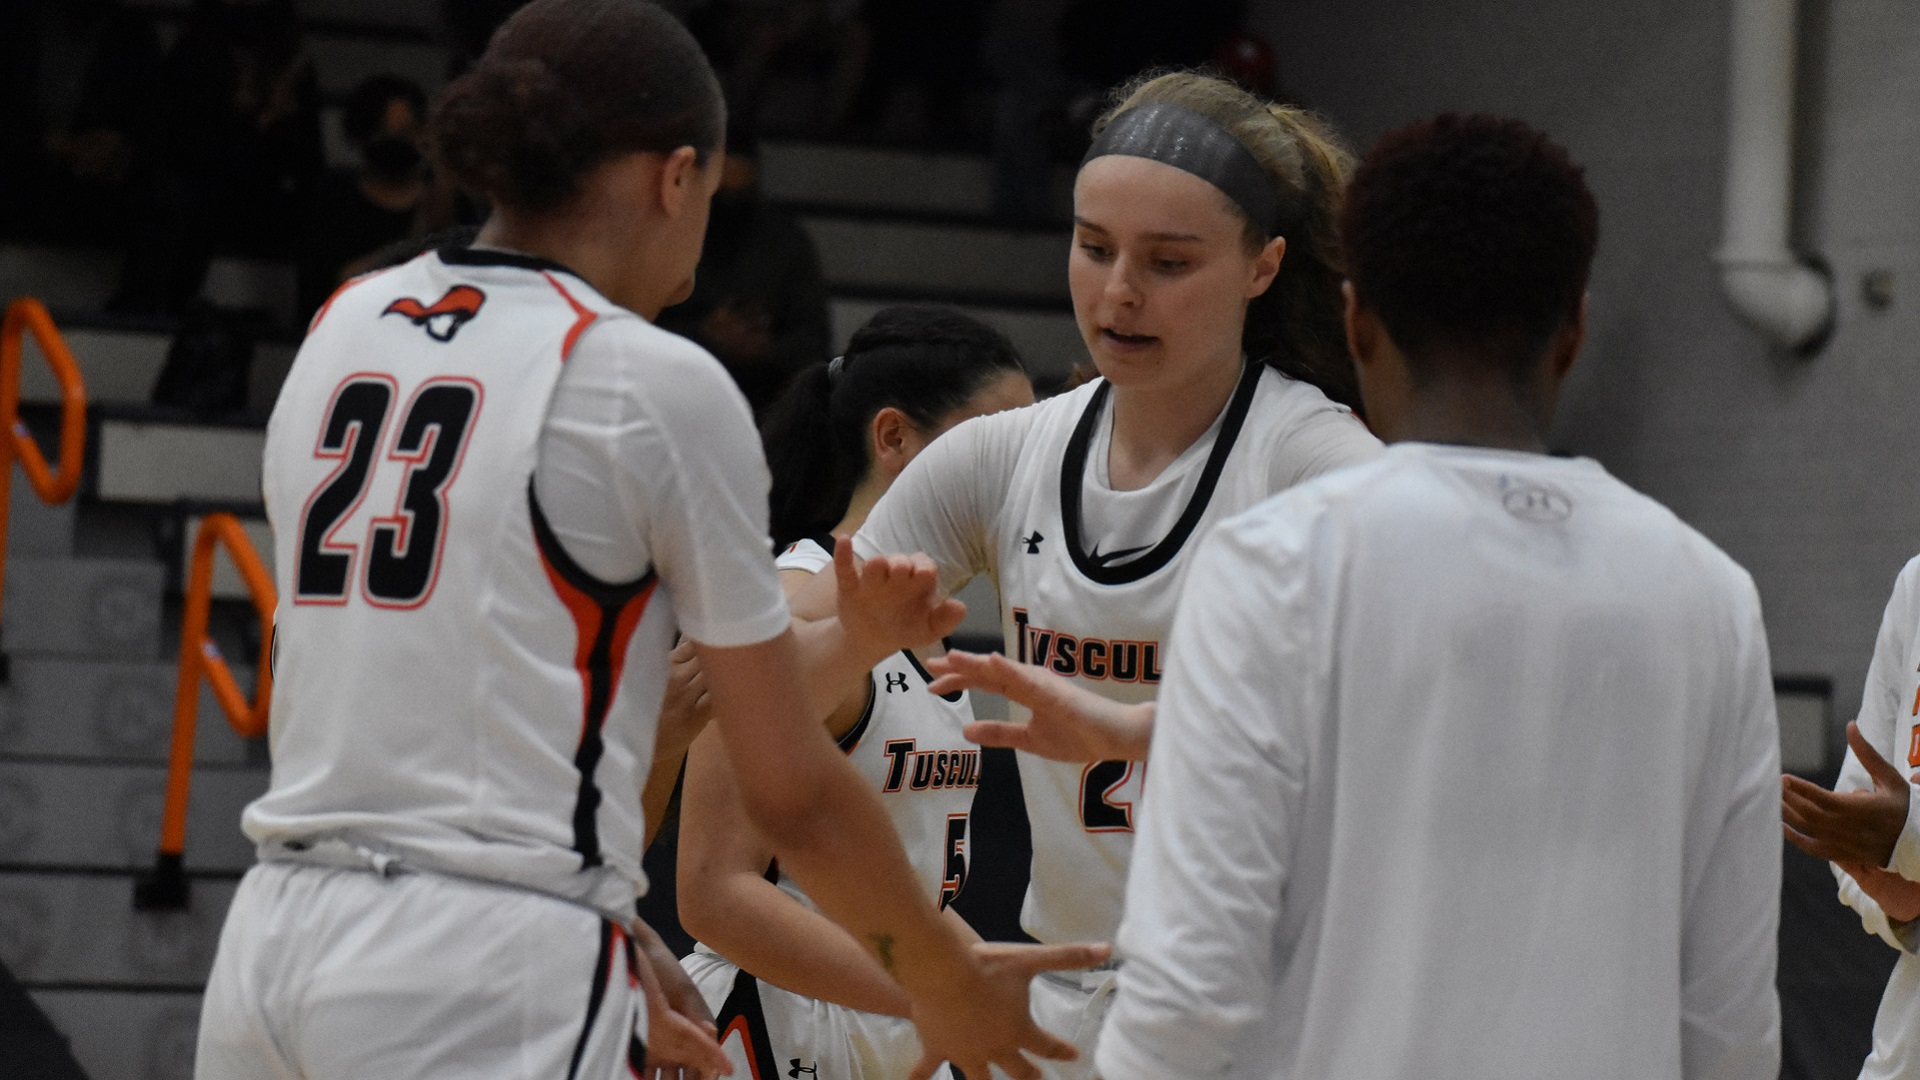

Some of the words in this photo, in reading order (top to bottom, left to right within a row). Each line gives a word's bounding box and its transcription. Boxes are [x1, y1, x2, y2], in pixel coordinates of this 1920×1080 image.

[293, 372, 484, 611] 23
[883, 738, 982, 792] TUSCUL
[1078, 759, 1147, 833] 2
[937, 813, 968, 912] 5
